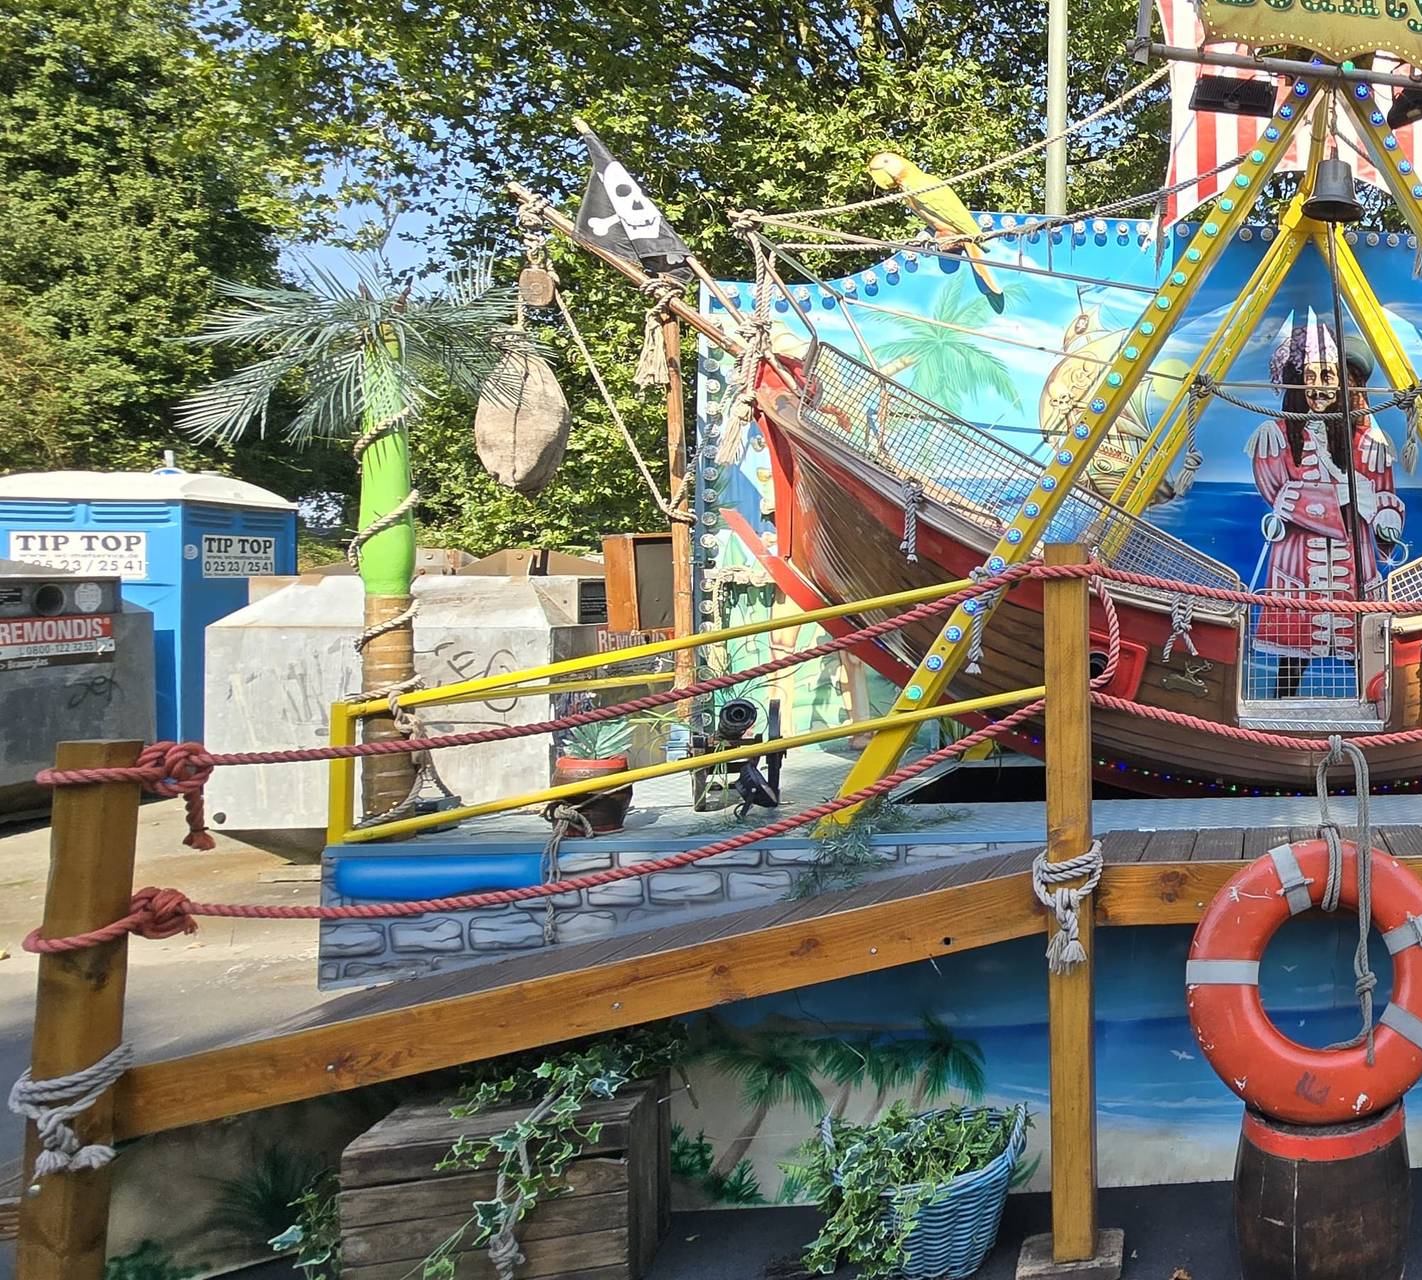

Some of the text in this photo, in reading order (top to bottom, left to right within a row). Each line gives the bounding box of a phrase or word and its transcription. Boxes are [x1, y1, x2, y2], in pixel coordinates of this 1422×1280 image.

[15, 535, 142, 552] TIP TOP
[204, 537, 273, 554] TIP TOP
